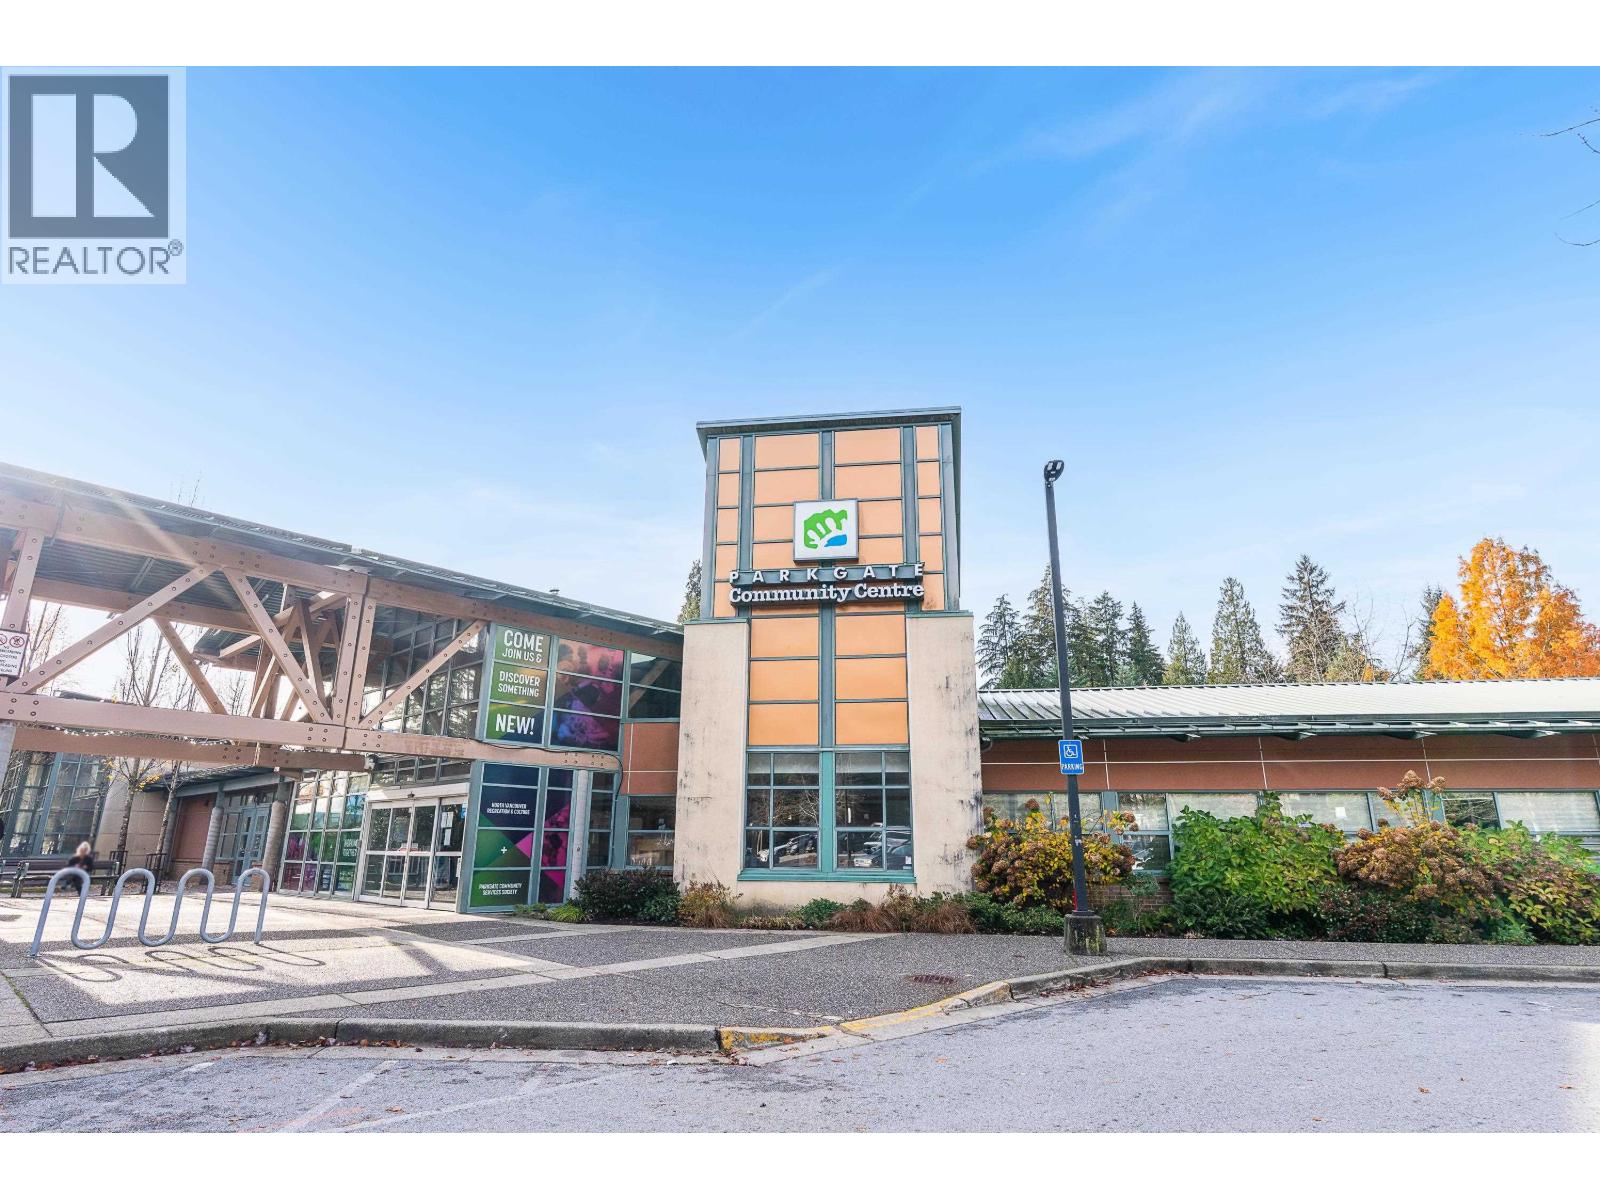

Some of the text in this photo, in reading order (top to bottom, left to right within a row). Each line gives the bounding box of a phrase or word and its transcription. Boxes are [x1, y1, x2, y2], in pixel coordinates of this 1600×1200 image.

[729, 563, 925, 583] PARKGATE
[729, 582, 925, 603] Community Centre
[503, 630, 544, 653] COME
[502, 647, 543, 663] JOIN US &
[499, 670, 541, 687] DISCOVER
[497, 683, 540, 698] SOMETHING
[495, 713, 535, 736] NEW!
